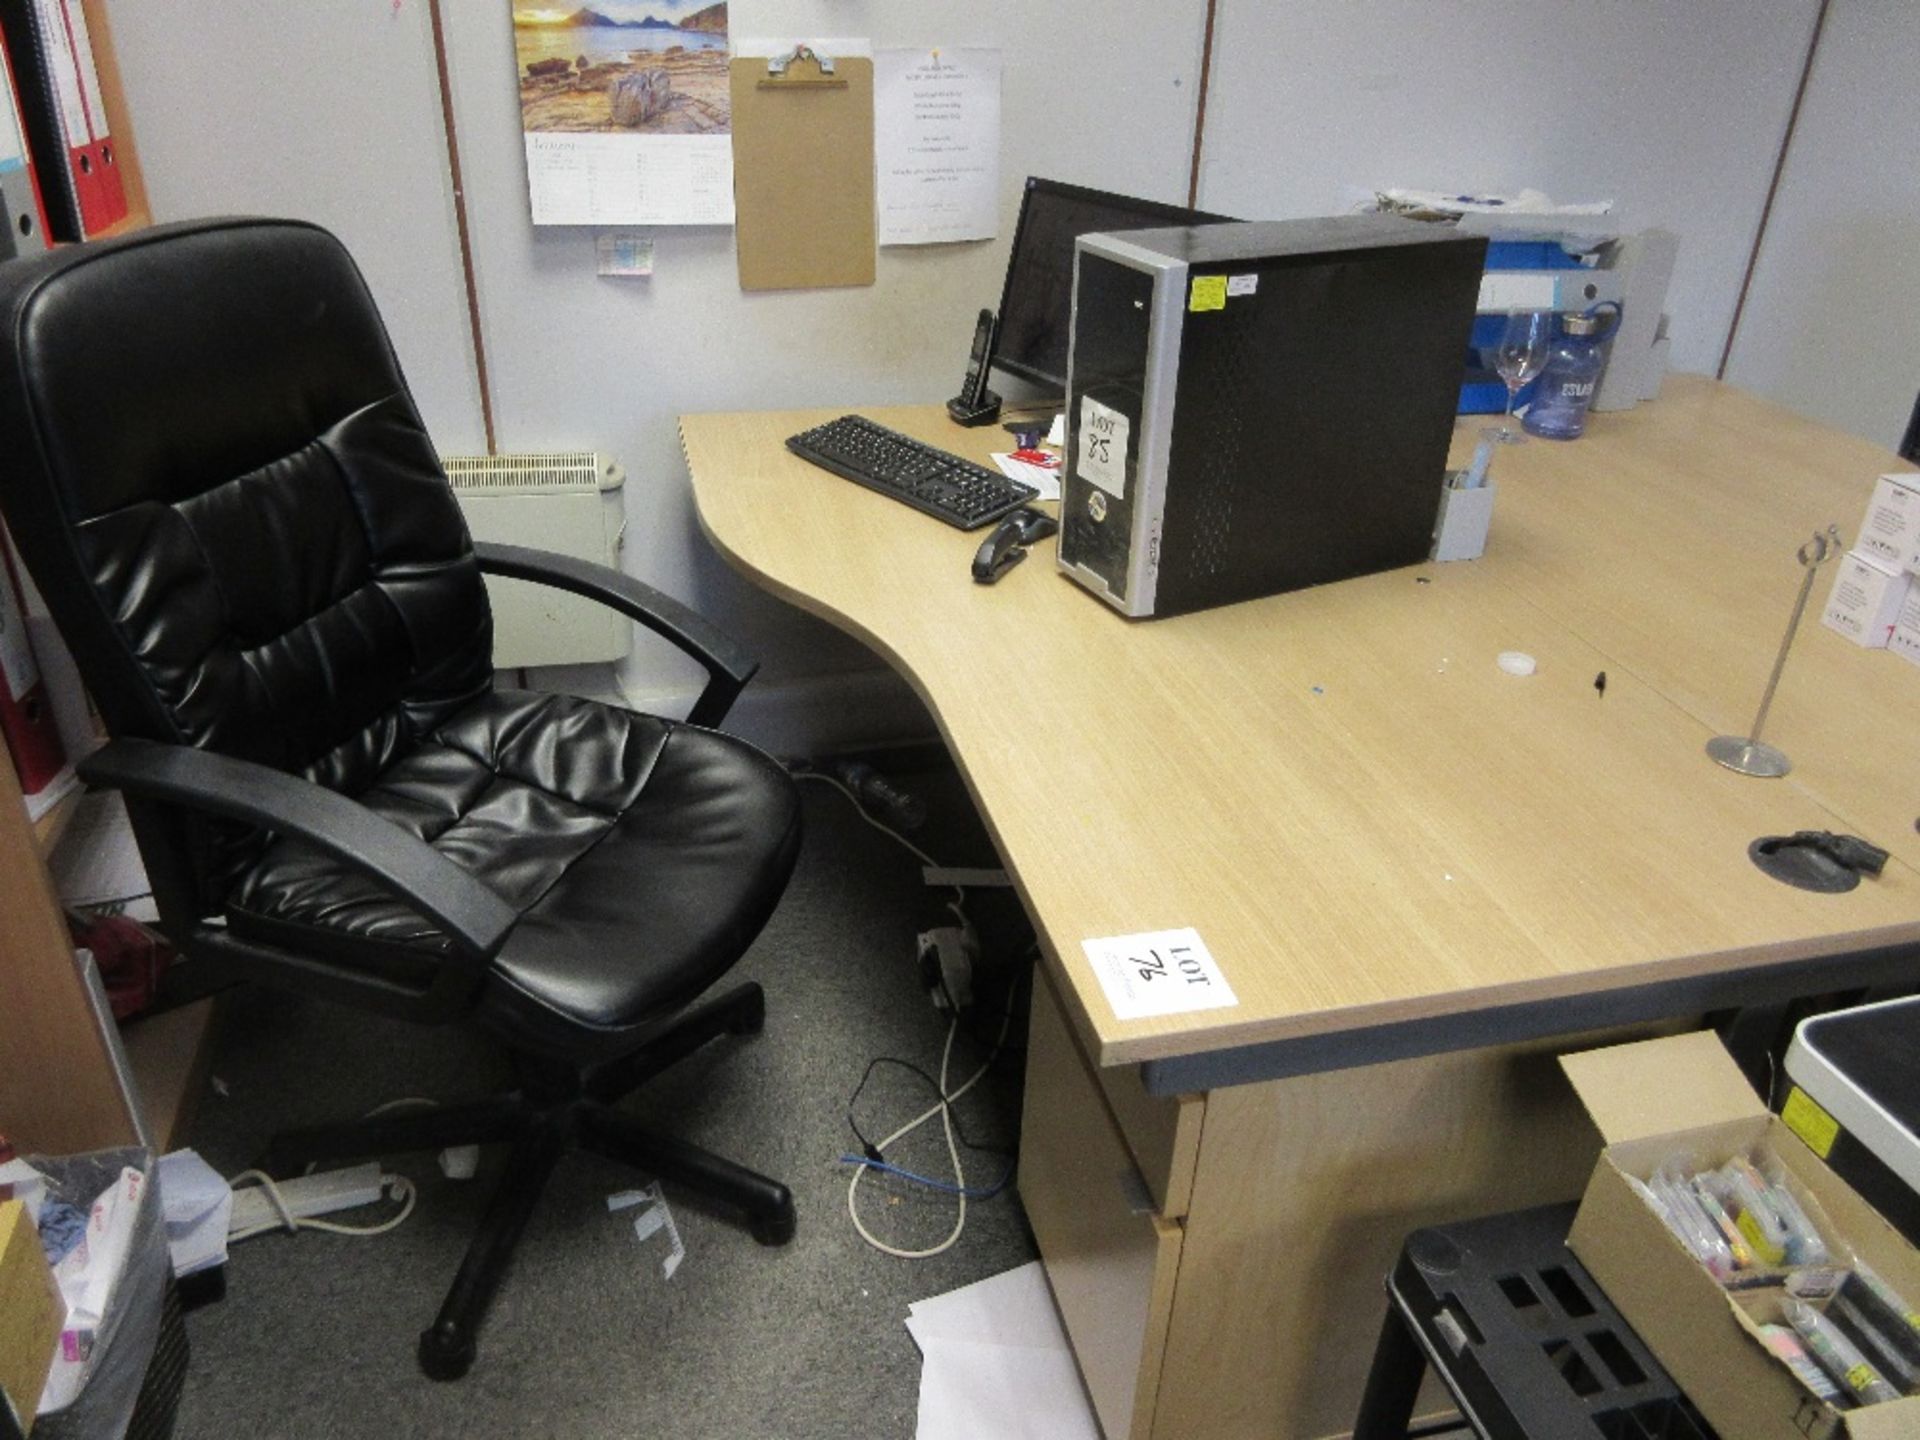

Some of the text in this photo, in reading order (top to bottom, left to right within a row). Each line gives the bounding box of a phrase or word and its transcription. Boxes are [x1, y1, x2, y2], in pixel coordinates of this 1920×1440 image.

[1090, 411, 1116, 436] LOT
[1128, 949, 1168, 983] 76
[1169, 946, 1211, 987] LOT
